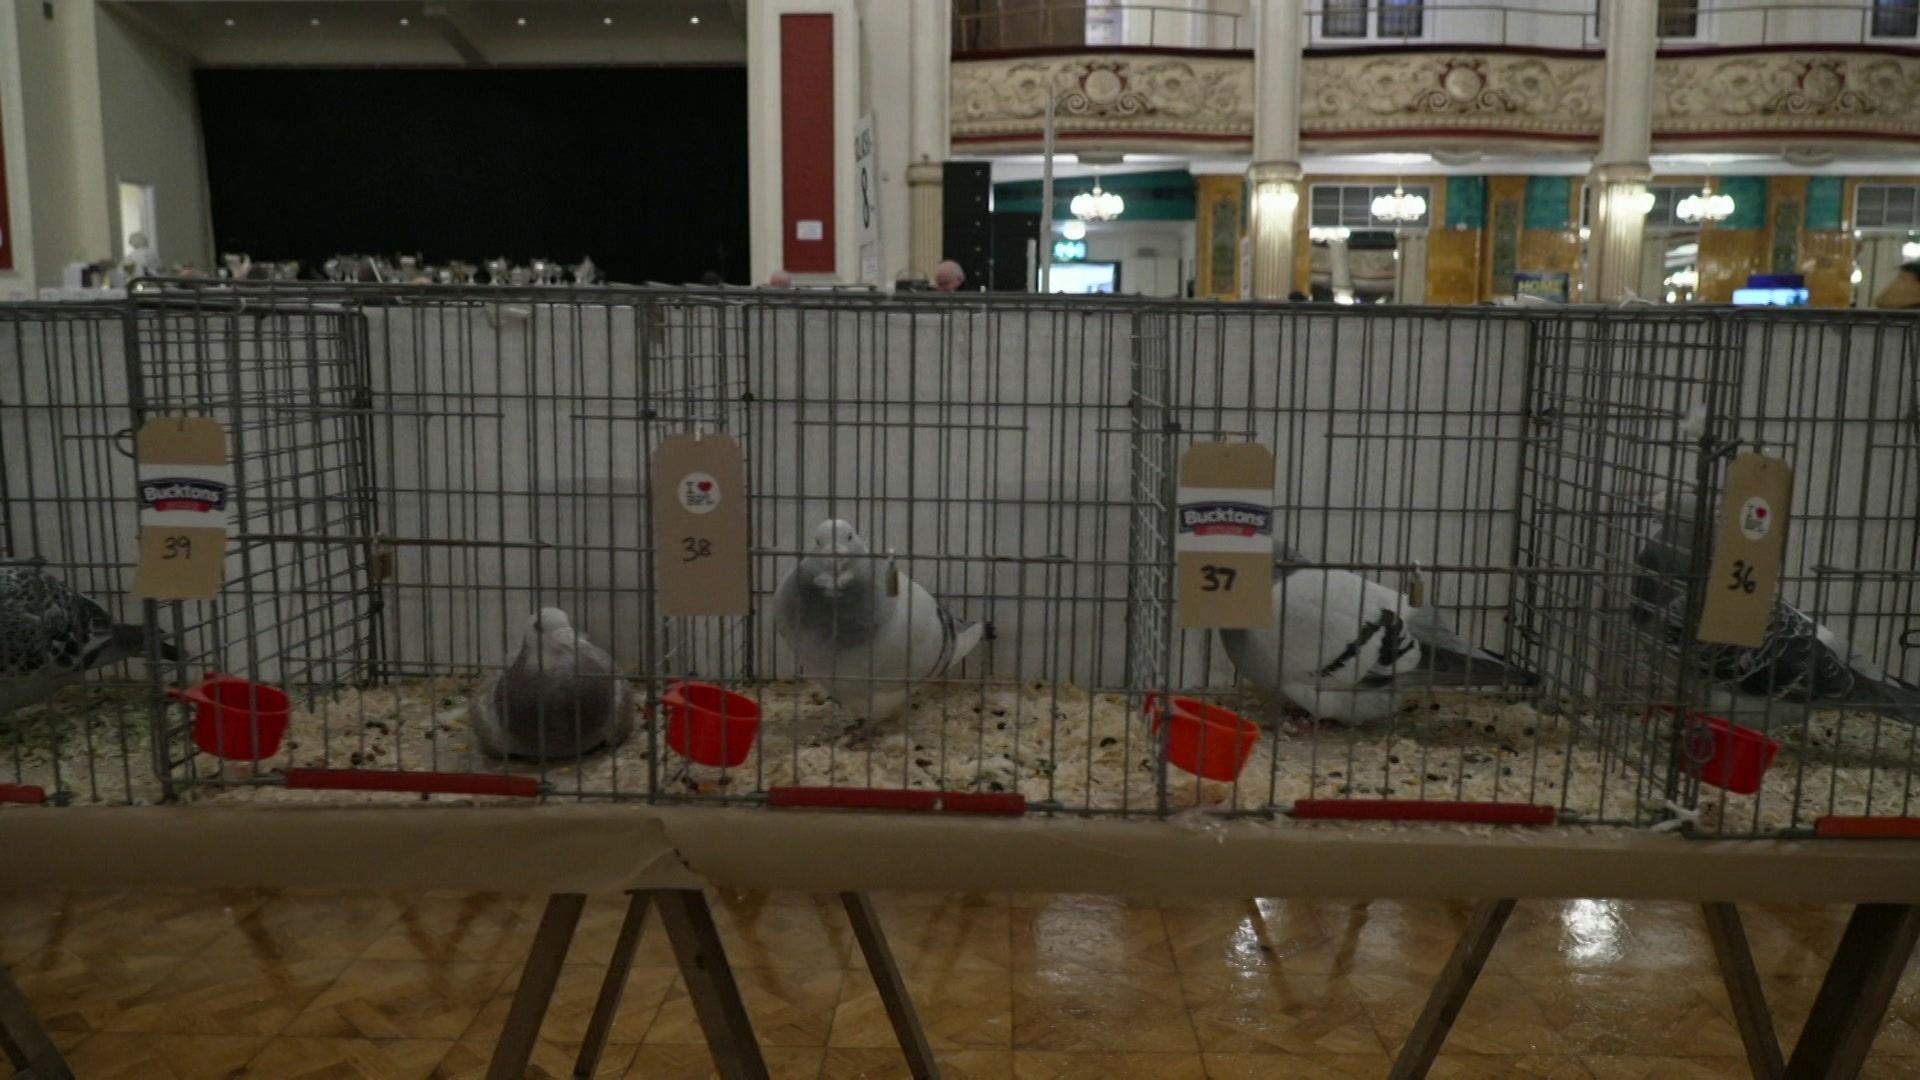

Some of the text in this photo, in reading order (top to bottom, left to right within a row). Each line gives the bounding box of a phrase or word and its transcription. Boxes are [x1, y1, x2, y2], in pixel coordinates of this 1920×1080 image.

[144, 484, 219, 502] Bucktons
[1183, 508, 1265, 526] Bucktons
[162, 536, 191, 560] 39
[682, 536, 713, 562] 38
[1201, 565, 1236, 592] 37
[1728, 560, 1756, 594] 36
